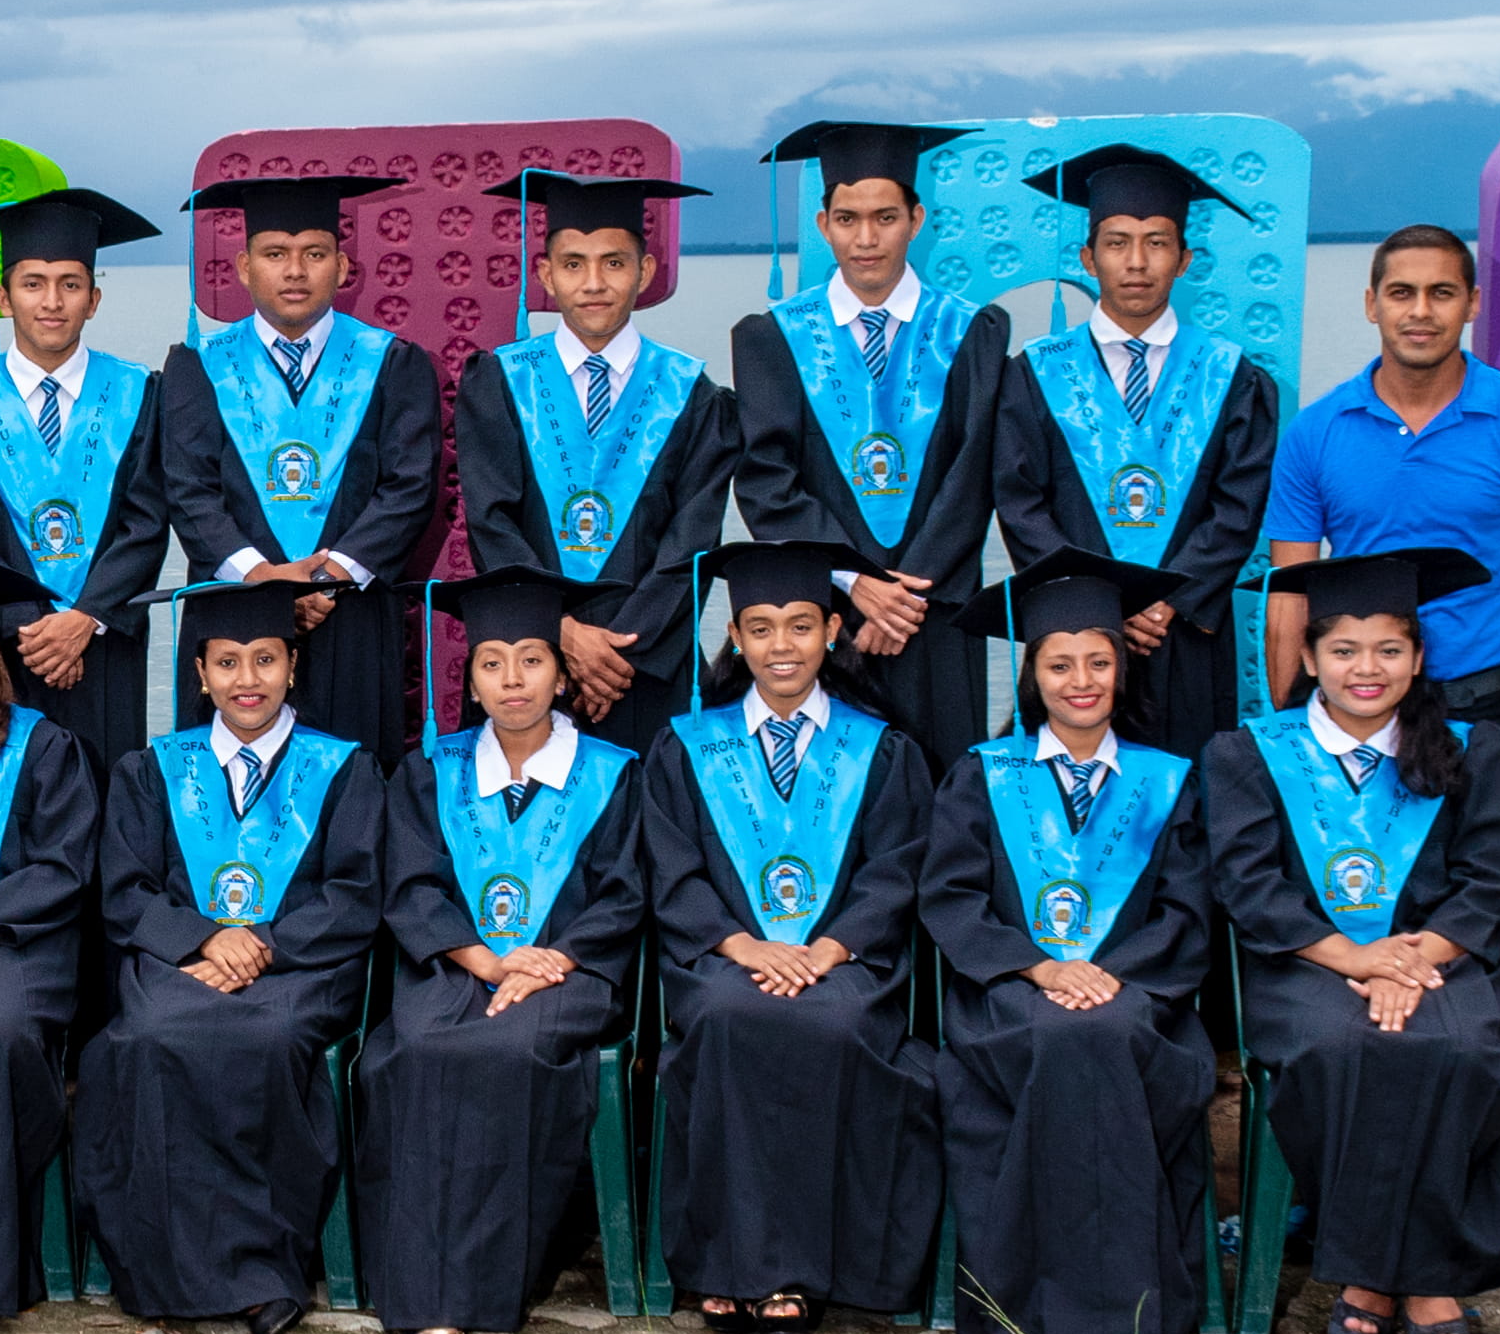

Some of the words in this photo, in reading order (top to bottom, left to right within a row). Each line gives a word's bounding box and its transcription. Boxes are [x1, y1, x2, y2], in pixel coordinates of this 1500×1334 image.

[226, 351, 263, 434] EFRAIN
[323, 339, 357, 439] INFOMBI
[807, 318, 852, 422] BRANDON
[898, 318, 937, 424] INFOMBI
[1060, 362, 1101, 436] BYRON
[1158, 346, 1204, 450] INFOMBI
[81, 380, 112, 483] INFOMBI
[530, 360, 578, 494] RIGOBERTO
[612, 373, 661, 470] INFOMBI
[182, 754, 215, 842] GLADYS
[263, 758, 313, 858] INFOMBI
[534, 761, 586, 863] INFOMBI
[724, 754, 768, 850] HEIZEL
[811, 724, 852, 827] INFOMBI
[1016, 770, 1052, 879] JULIETA
[1095, 776, 1149, 873] INFOMBI
[1289, 739, 1331, 831] EUNICE
